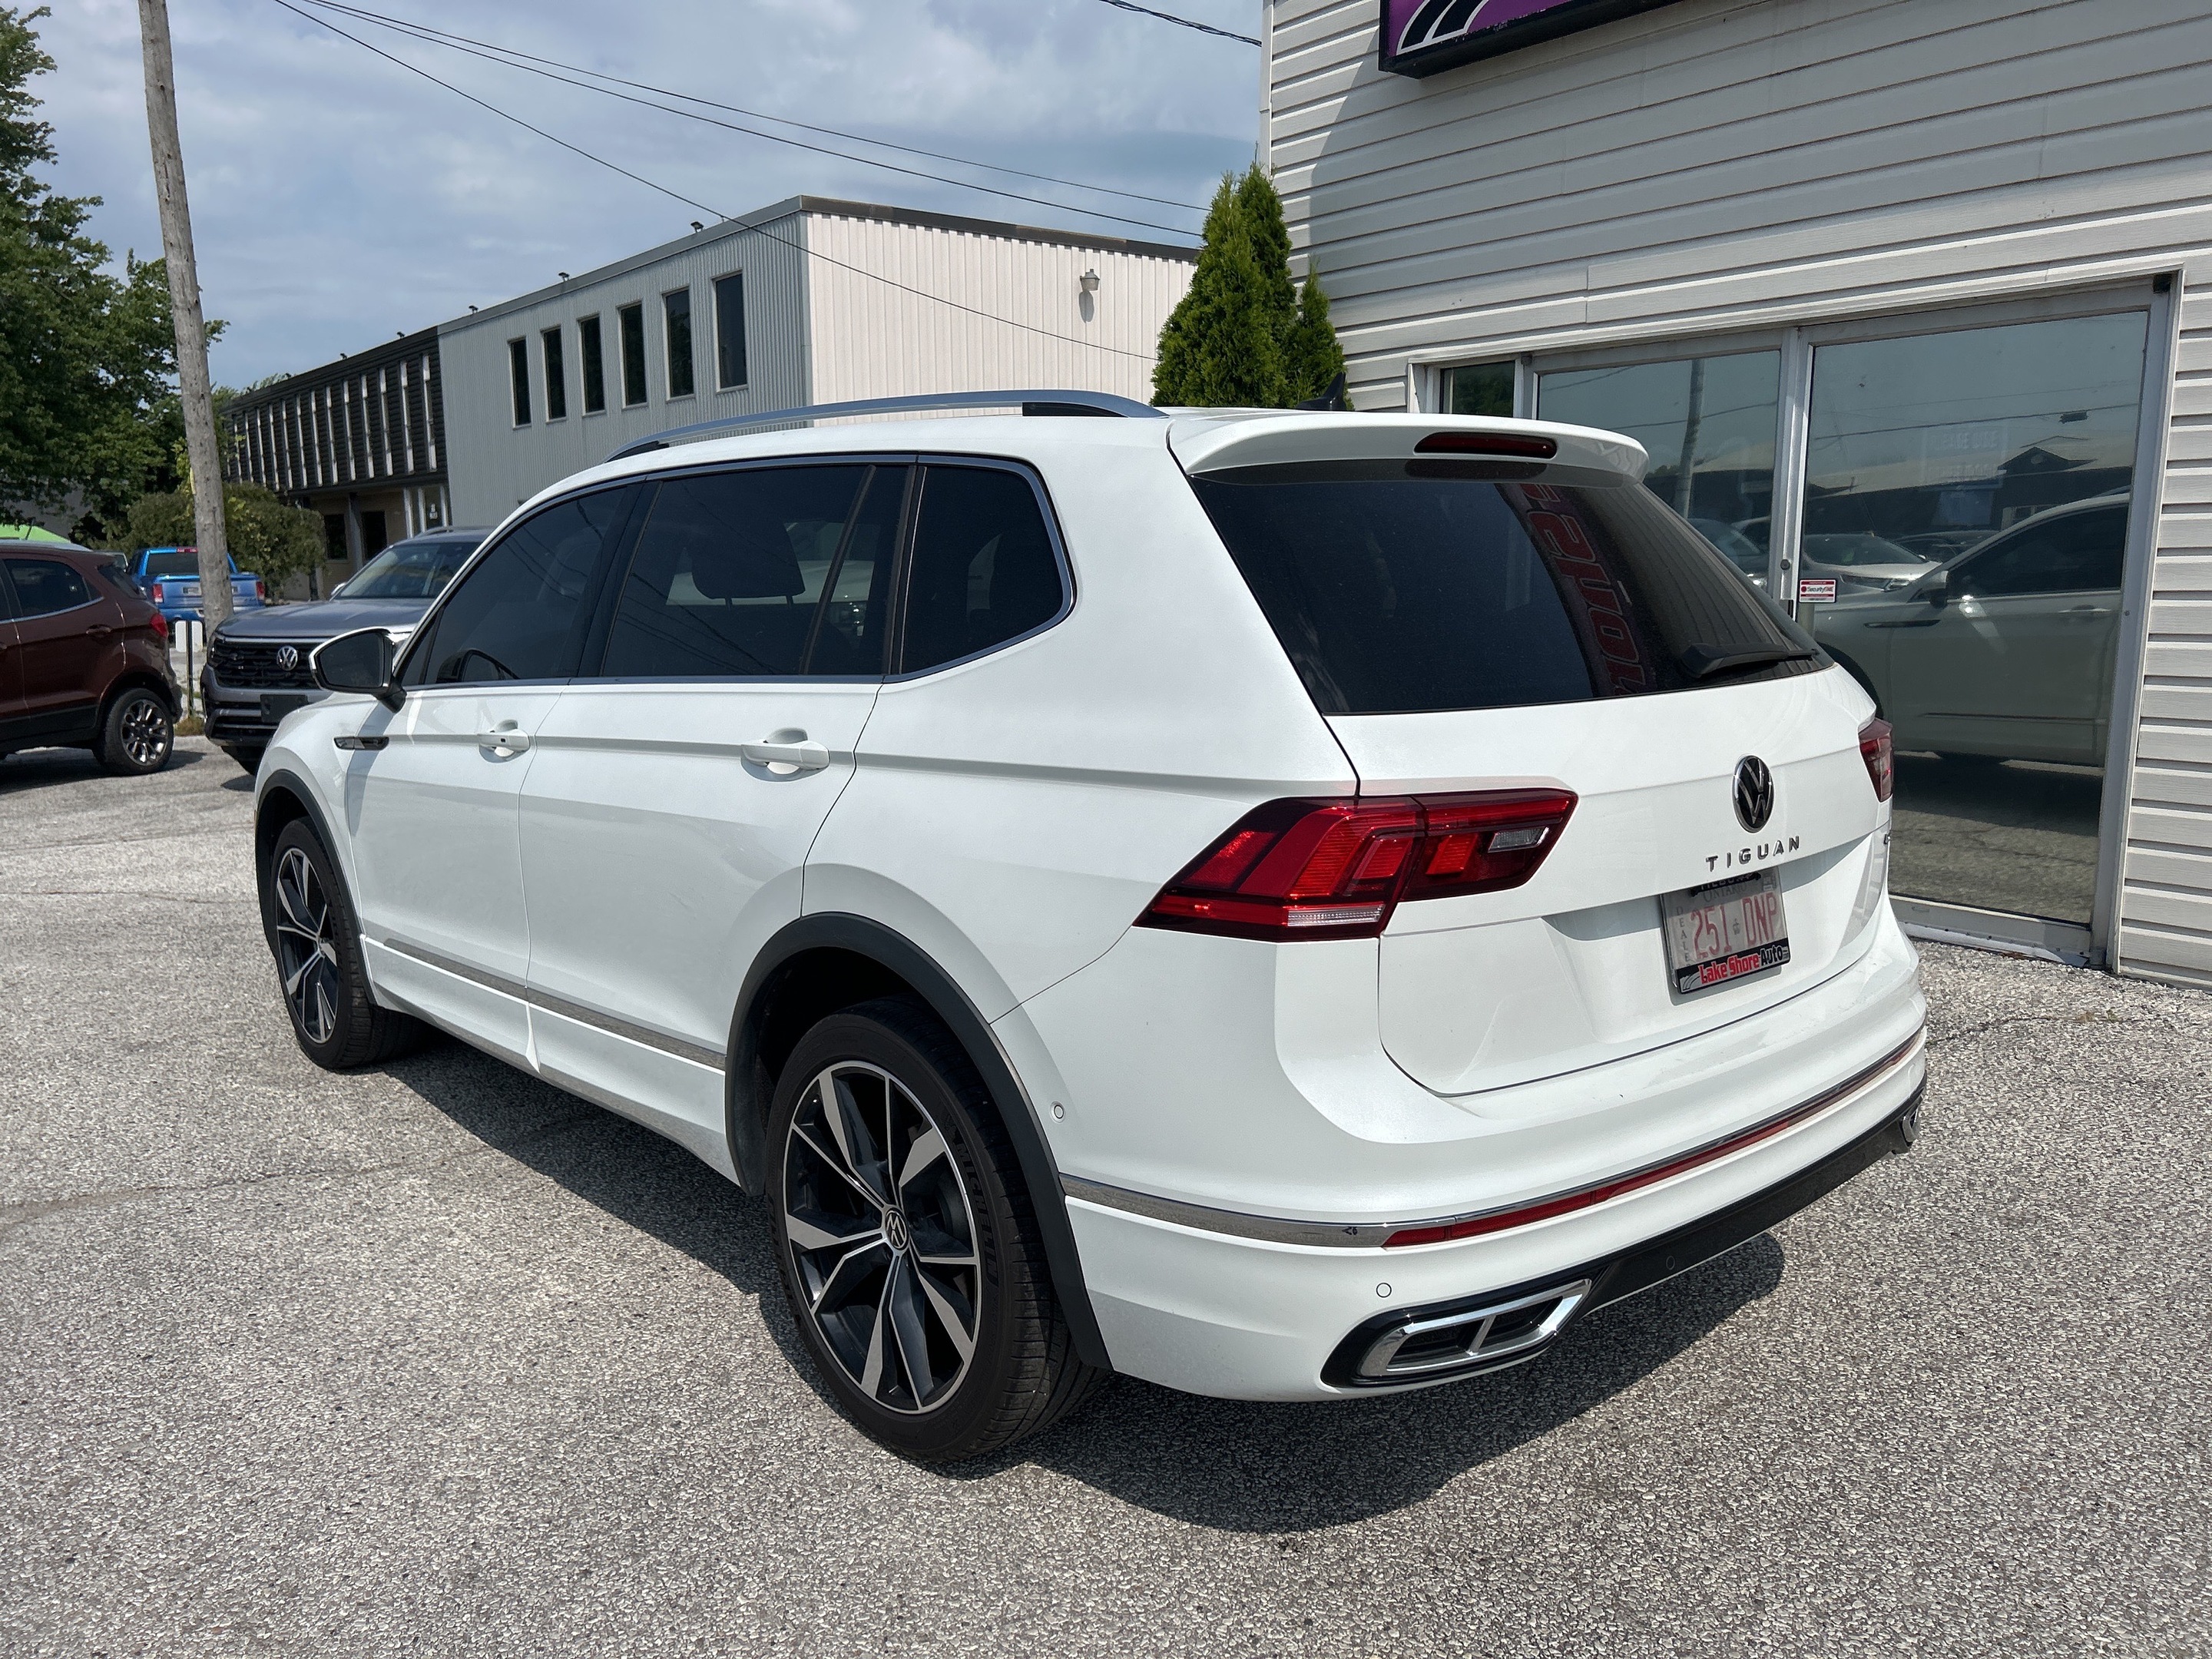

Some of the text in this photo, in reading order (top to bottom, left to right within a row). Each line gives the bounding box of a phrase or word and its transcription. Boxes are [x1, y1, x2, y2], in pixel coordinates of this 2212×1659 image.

[1705, 835, 1800, 873] TIGUAN
[1690, 892, 1778, 960] 251 DNP
[1698, 961, 1727, 985] Lake
[1728, 953, 1760, 975] Shore
[1760, 945, 1783, 965] Auto
[955, 1143, 998, 1284] MICHELIN
